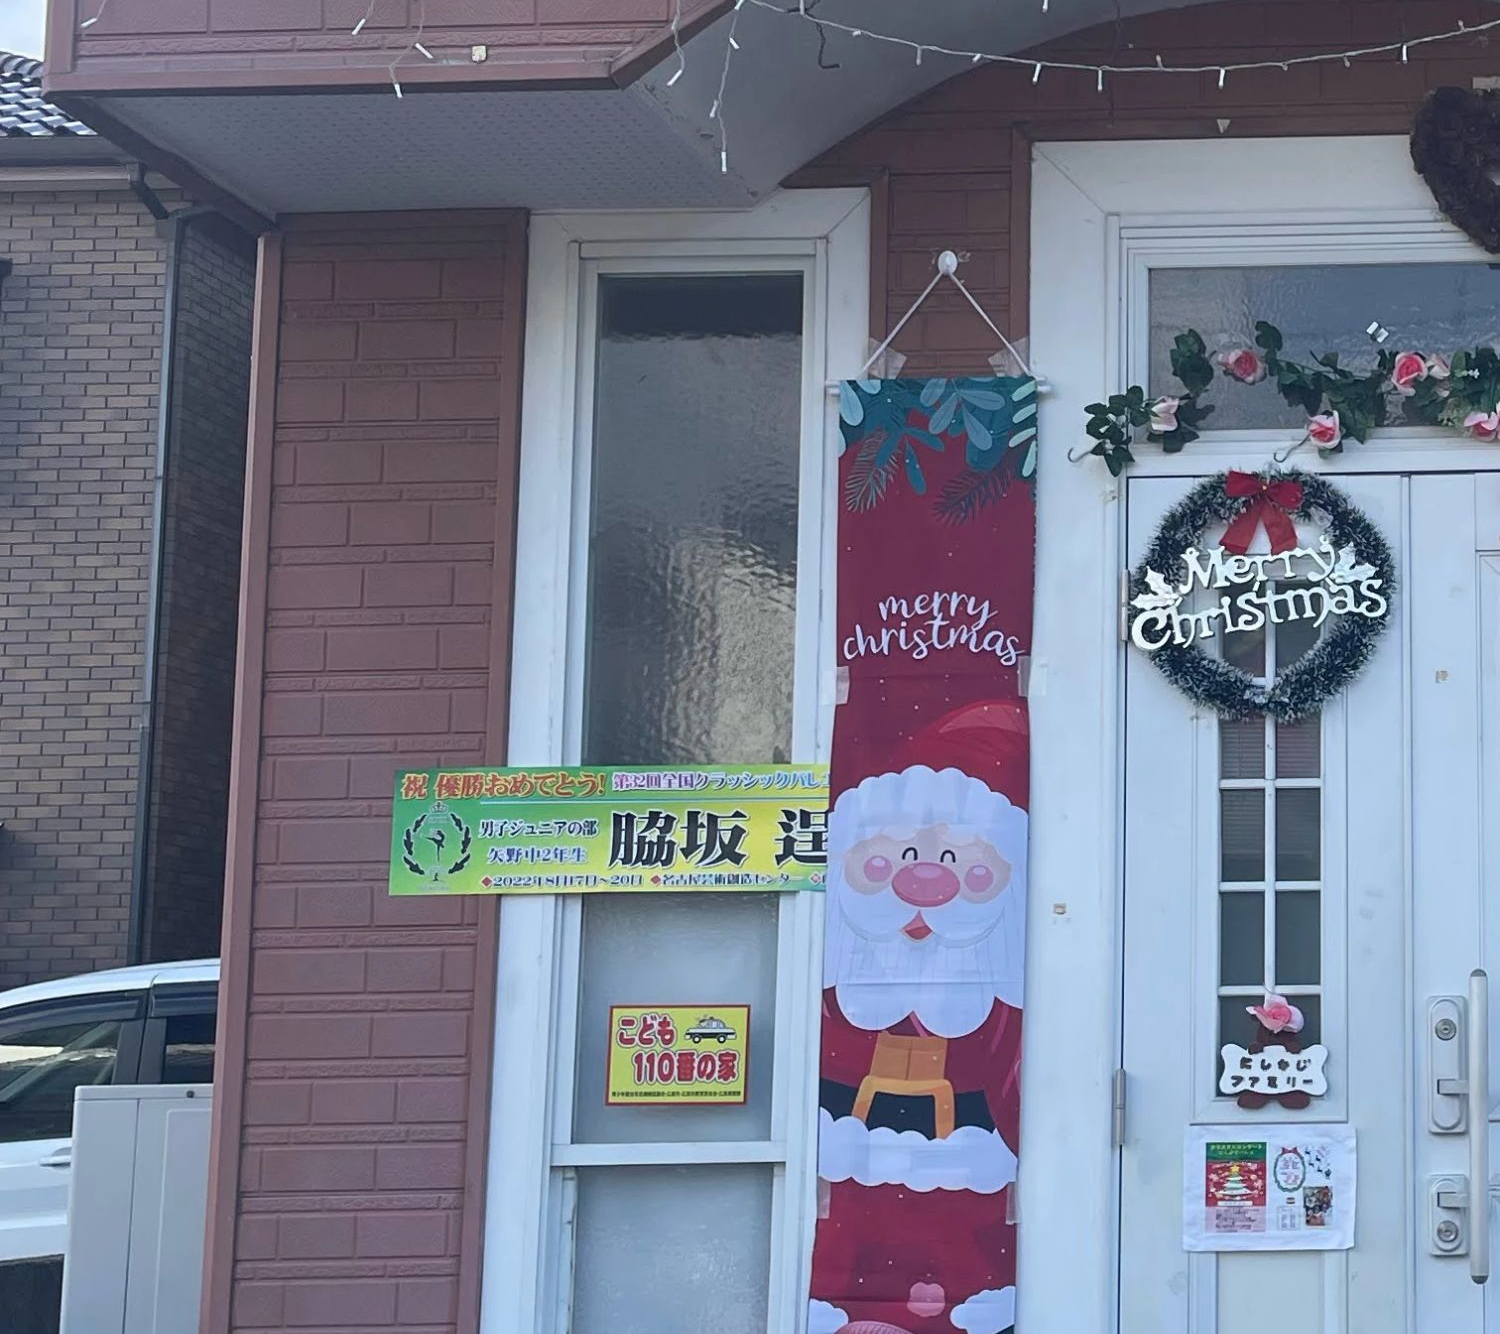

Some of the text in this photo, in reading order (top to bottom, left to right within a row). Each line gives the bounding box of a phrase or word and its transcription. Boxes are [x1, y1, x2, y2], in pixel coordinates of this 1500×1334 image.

[1178, 536, 1335, 595] Merry
[878, 591, 999, 632] merry
[1131, 578, 1388, 650] Christmas
[843, 612, 1026, 666] christmas
[401, 773, 428, 800] 祝
[480, 819, 598, 837] 男子ジュニアの部
[608, 809, 748, 868] 脇坂
[489, 847, 586, 864] 矢野中2年生
[618, 1014, 676, 1046] こども
[633, 1050, 738, 1082] 110番の家
[1239, 1056, 1312, 1072] にしかじ
[1230, 1074, 1314, 1089] ファミリー
